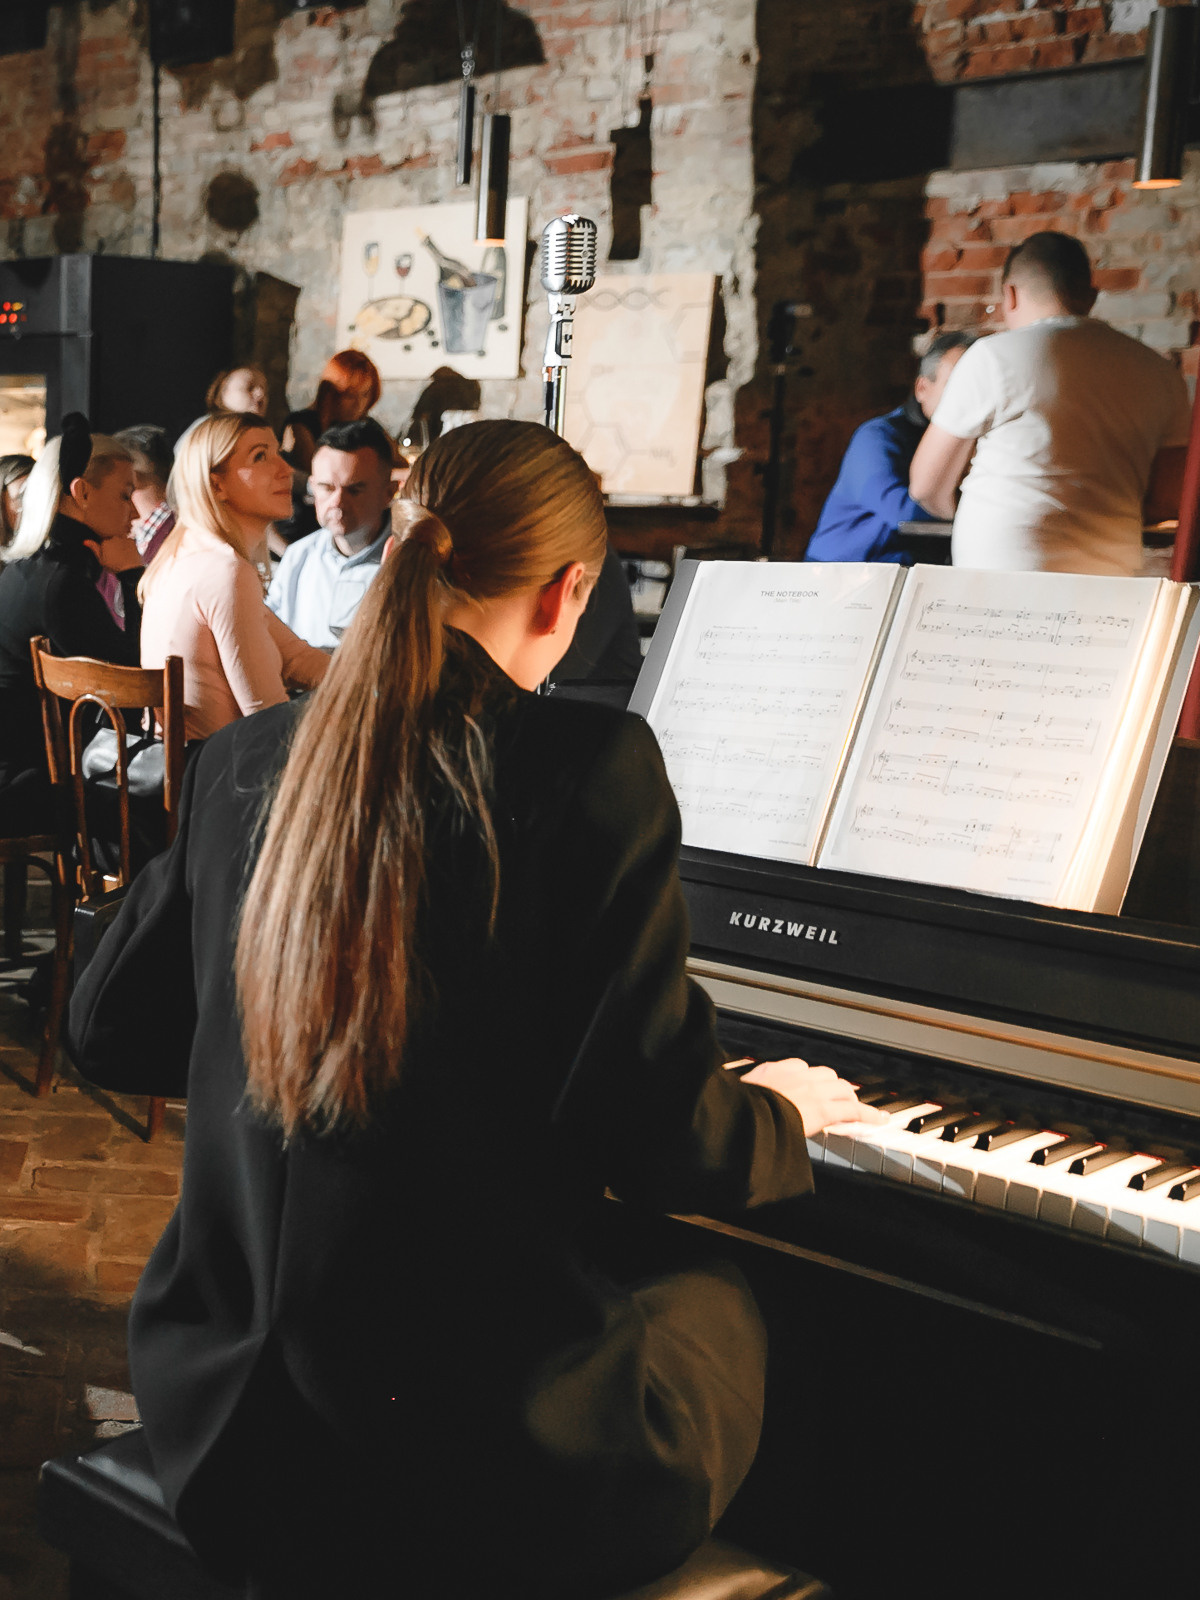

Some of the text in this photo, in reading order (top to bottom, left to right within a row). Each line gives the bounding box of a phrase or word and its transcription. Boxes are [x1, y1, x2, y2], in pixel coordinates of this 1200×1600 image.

[760, 590, 820, 598] THE NOTEBOOK
[729, 911, 838, 945] KURZWEIL
